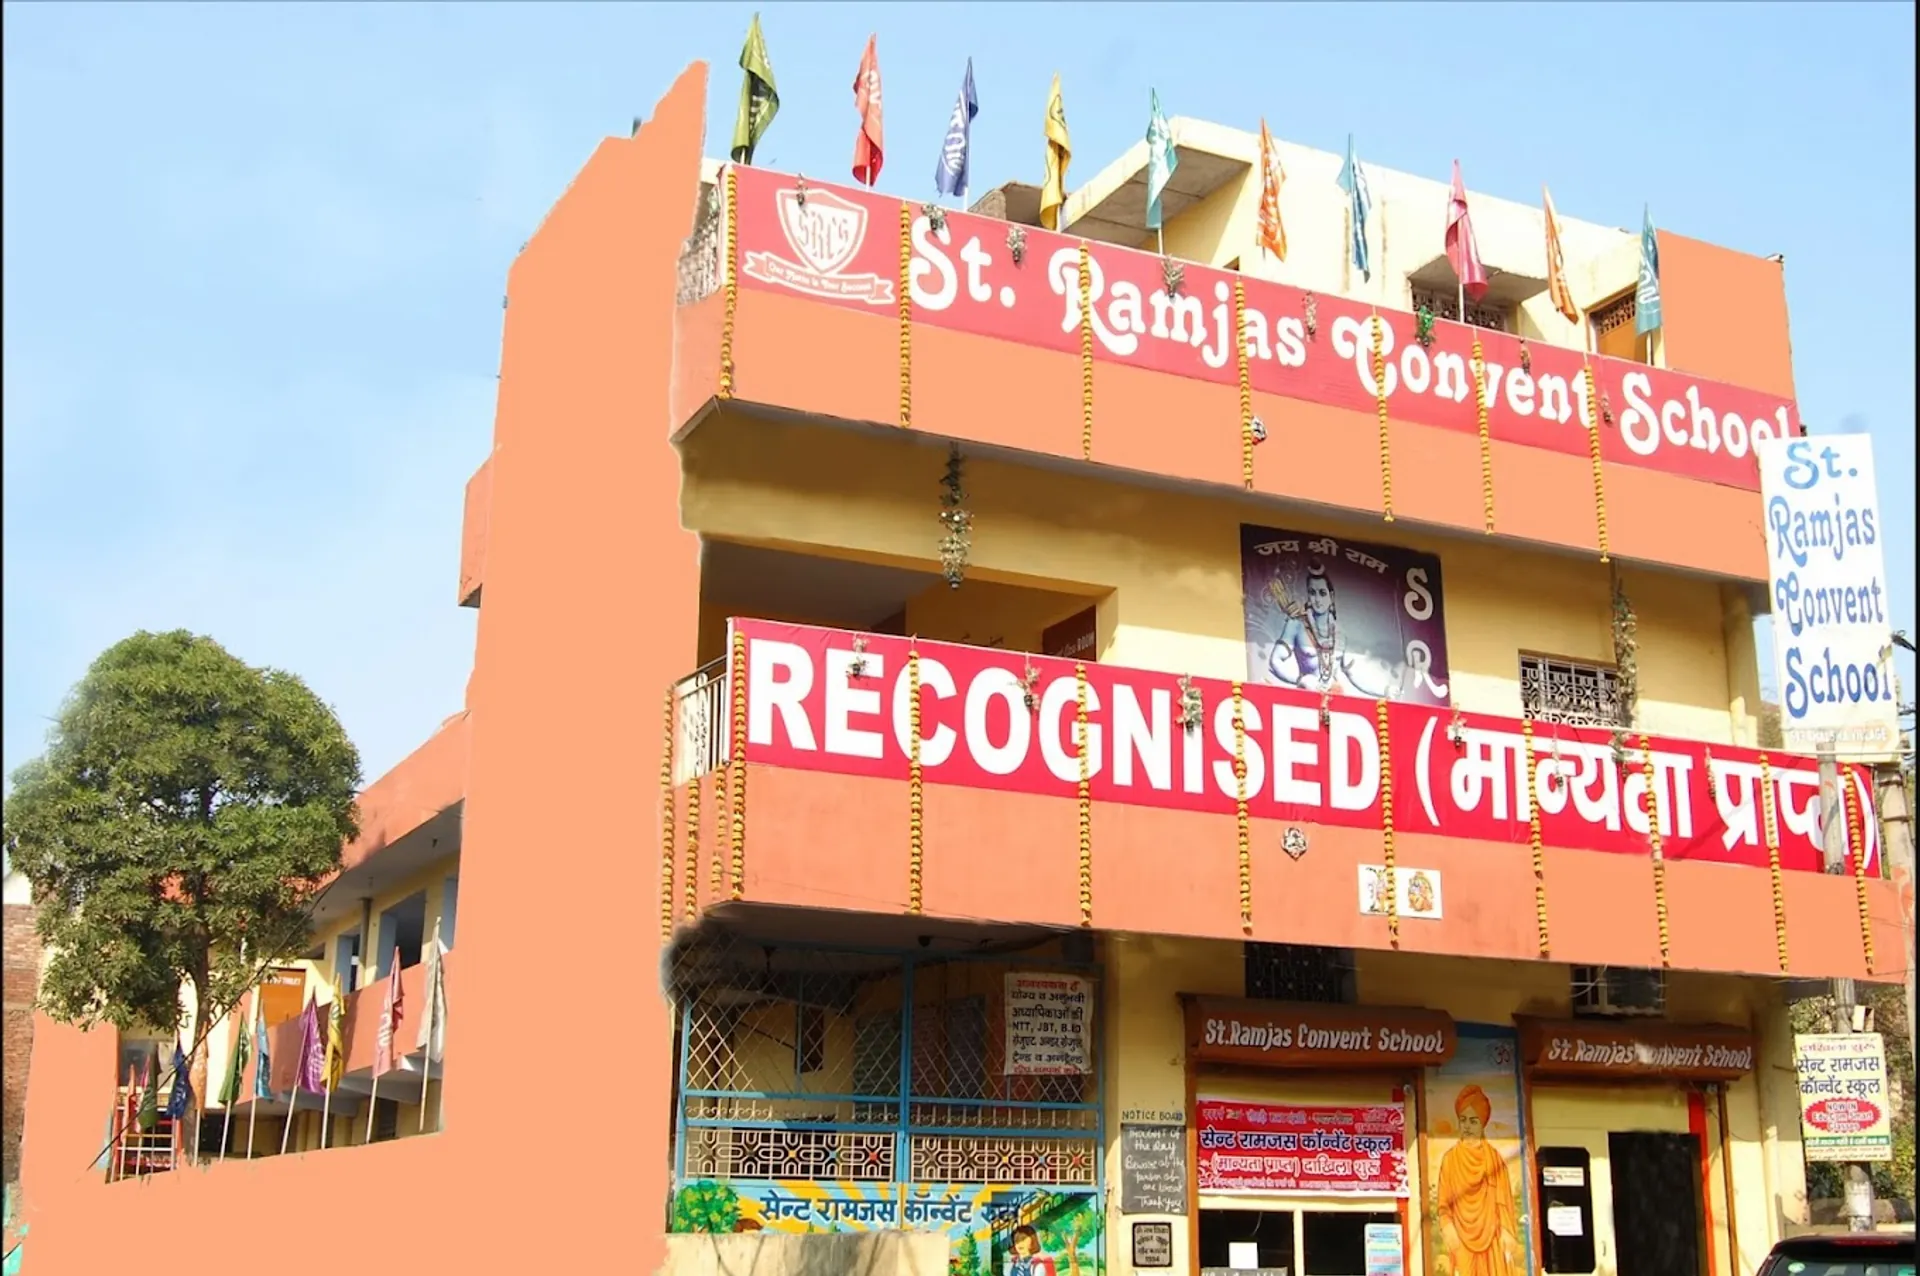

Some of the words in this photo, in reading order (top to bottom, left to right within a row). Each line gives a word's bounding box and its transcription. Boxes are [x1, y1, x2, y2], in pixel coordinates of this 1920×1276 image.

[908, 216, 1017, 311] St.
[1048, 247, 1306, 369] Ramjas
[1331, 314, 1596, 431] Convent
[1620, 372, 1791, 459] School
[1783, 441, 1859, 490] St.
[1769, 493, 1877, 568] Ramjas
[1253, 540, 1299, 556] जय
[1307, 538, 1339, 557] श्री
[1346, 548, 1389, 574] राम
[1776, 572, 1884, 639] Convent
[1785, 645, 1893, 722] School
[749, 638, 1382, 811] RECOGNISED
[1012, 1021, 1034, 1033] NTT,
[1037, 1022, 1058, 1035] JBT,
[1297, 1023, 1371, 1051] Convent
[1378, 1028, 1445, 1054] School
[1702, 1044, 1752, 1070] School
[1798, 1054, 1826, 1073] सेन्ट
[1830, 1056, 1880, 1073] रामजस
[1800, 1075, 1843, 1094] कॉन्वेंट
[1846, 1078, 1880, 1098] स्कूल
[1122, 1110, 1156, 1120] NOTICE
[1826, 1102, 1847, 1111] NOW
[1848, 1102, 1857, 1111] IN
[1201, 1125, 1235, 1150] सेन्ट
[1239, 1131, 1297, 1150] रामजस
[1354, 1134, 1393, 1158] स्कूल
[1302, 1153, 1351, 1175] दाखिला
[760, 1189, 812, 1222] सेन्ट
[817, 1196, 898, 1222] रामजस
[903, 1192, 973, 1224] कॉन्वेंट
